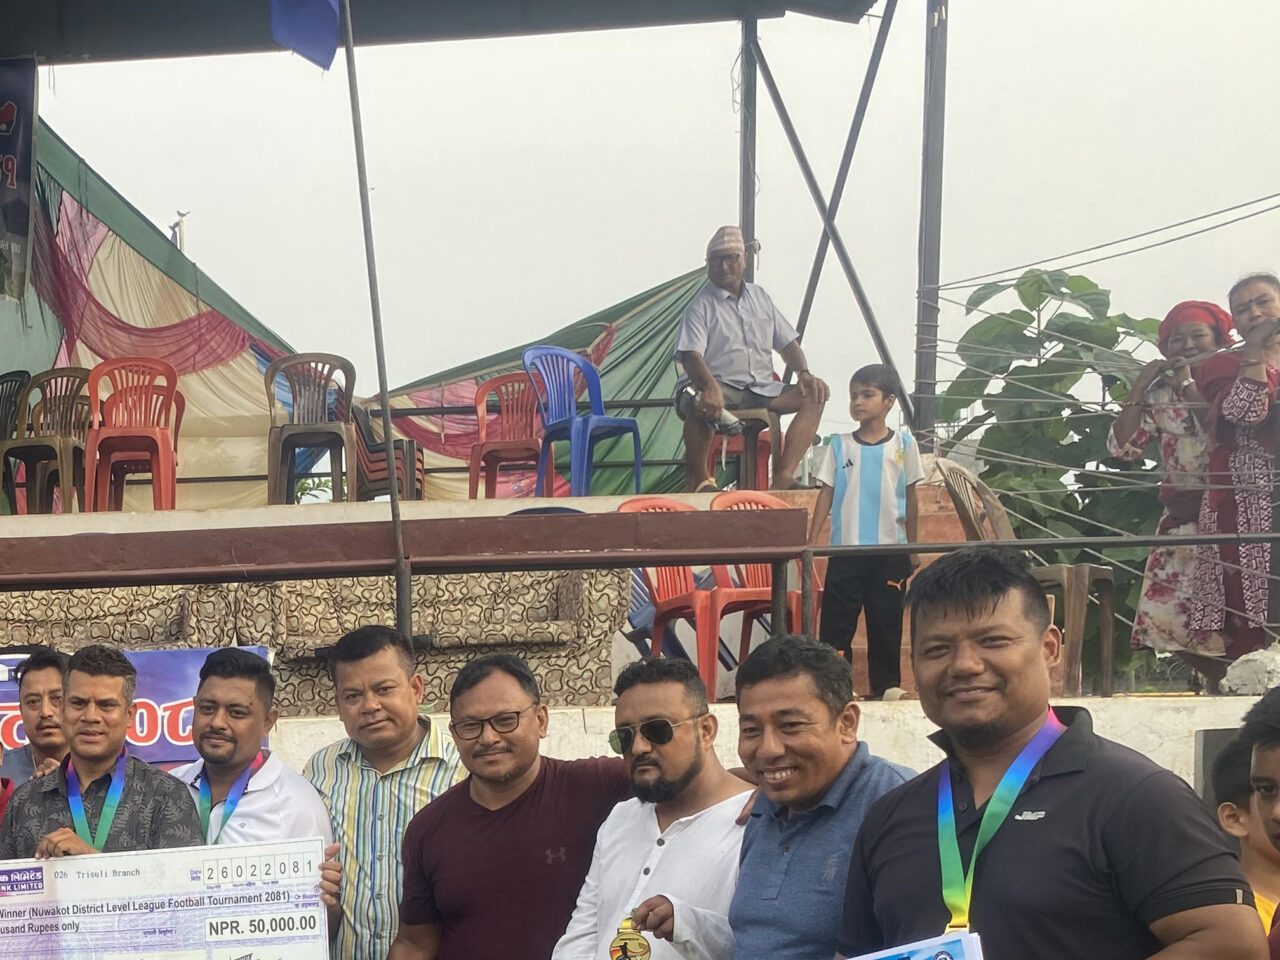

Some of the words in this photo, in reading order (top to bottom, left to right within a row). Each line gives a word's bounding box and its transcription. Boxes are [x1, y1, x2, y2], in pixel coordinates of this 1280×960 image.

[10, 871, 43, 882] लिमिटेड
[54, 870, 69, 879] 026
[76, 868, 108, 879] Trisuli
[112, 867, 141, 878] Branch
[13, 882, 43, 891] LIMITED
[29, 906, 70, 919] (Nuwakot
[72, 903, 104, 915] District
[106, 902, 130, 913] Level
[133, 900, 166, 914] League
[168, 896, 205, 909] Football
[207, 893, 263, 906] Tournament
[264, 890, 290, 903] 2081)
[27, 923, 59, 937] Rupees
[61, 921, 80, 934] only
[209, 920, 245, 936] NPR.
[249, 915, 317, 935] 50,000.00
